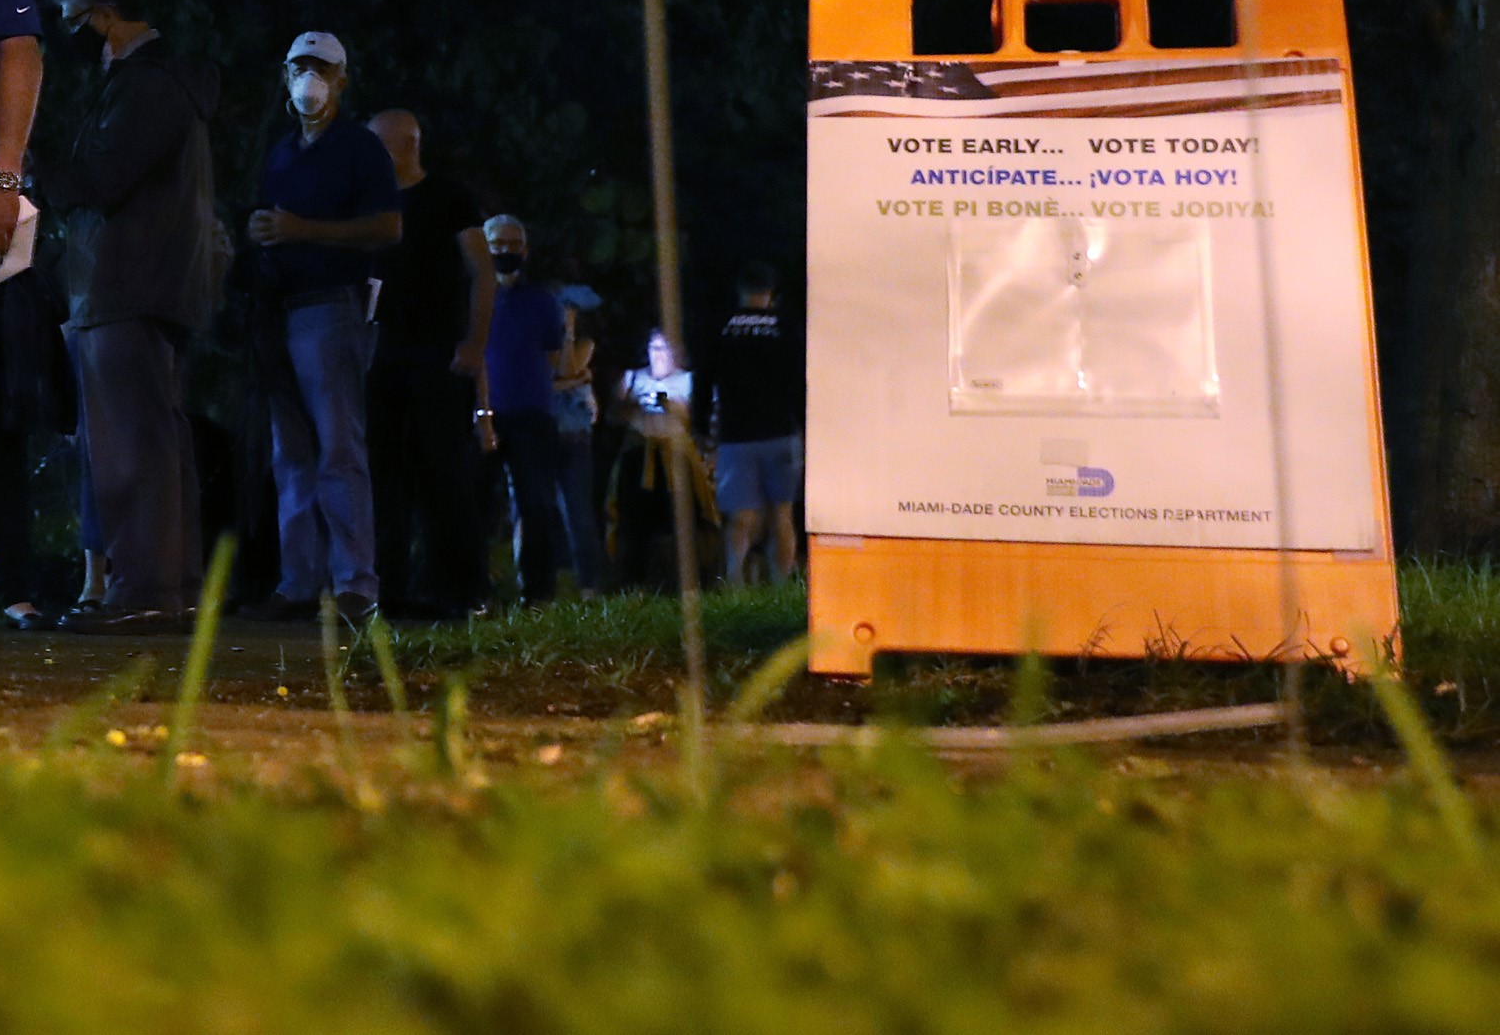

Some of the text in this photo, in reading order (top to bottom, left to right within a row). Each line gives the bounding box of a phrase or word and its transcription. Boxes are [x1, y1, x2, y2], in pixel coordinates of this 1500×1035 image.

[887, 138, 1260, 154] VOTE EARLY... VOTE TODAY!
[910, 165, 1238, 189] ANTICÍPATE... ¡VOTA HOY!
[876, 196, 1275, 218] VOTE PI BONÈ... VOTE JODIYA!
[897, 500, 1273, 523] MIAMI-DADE COUNTY ELECTIONS DEPARTMENT
